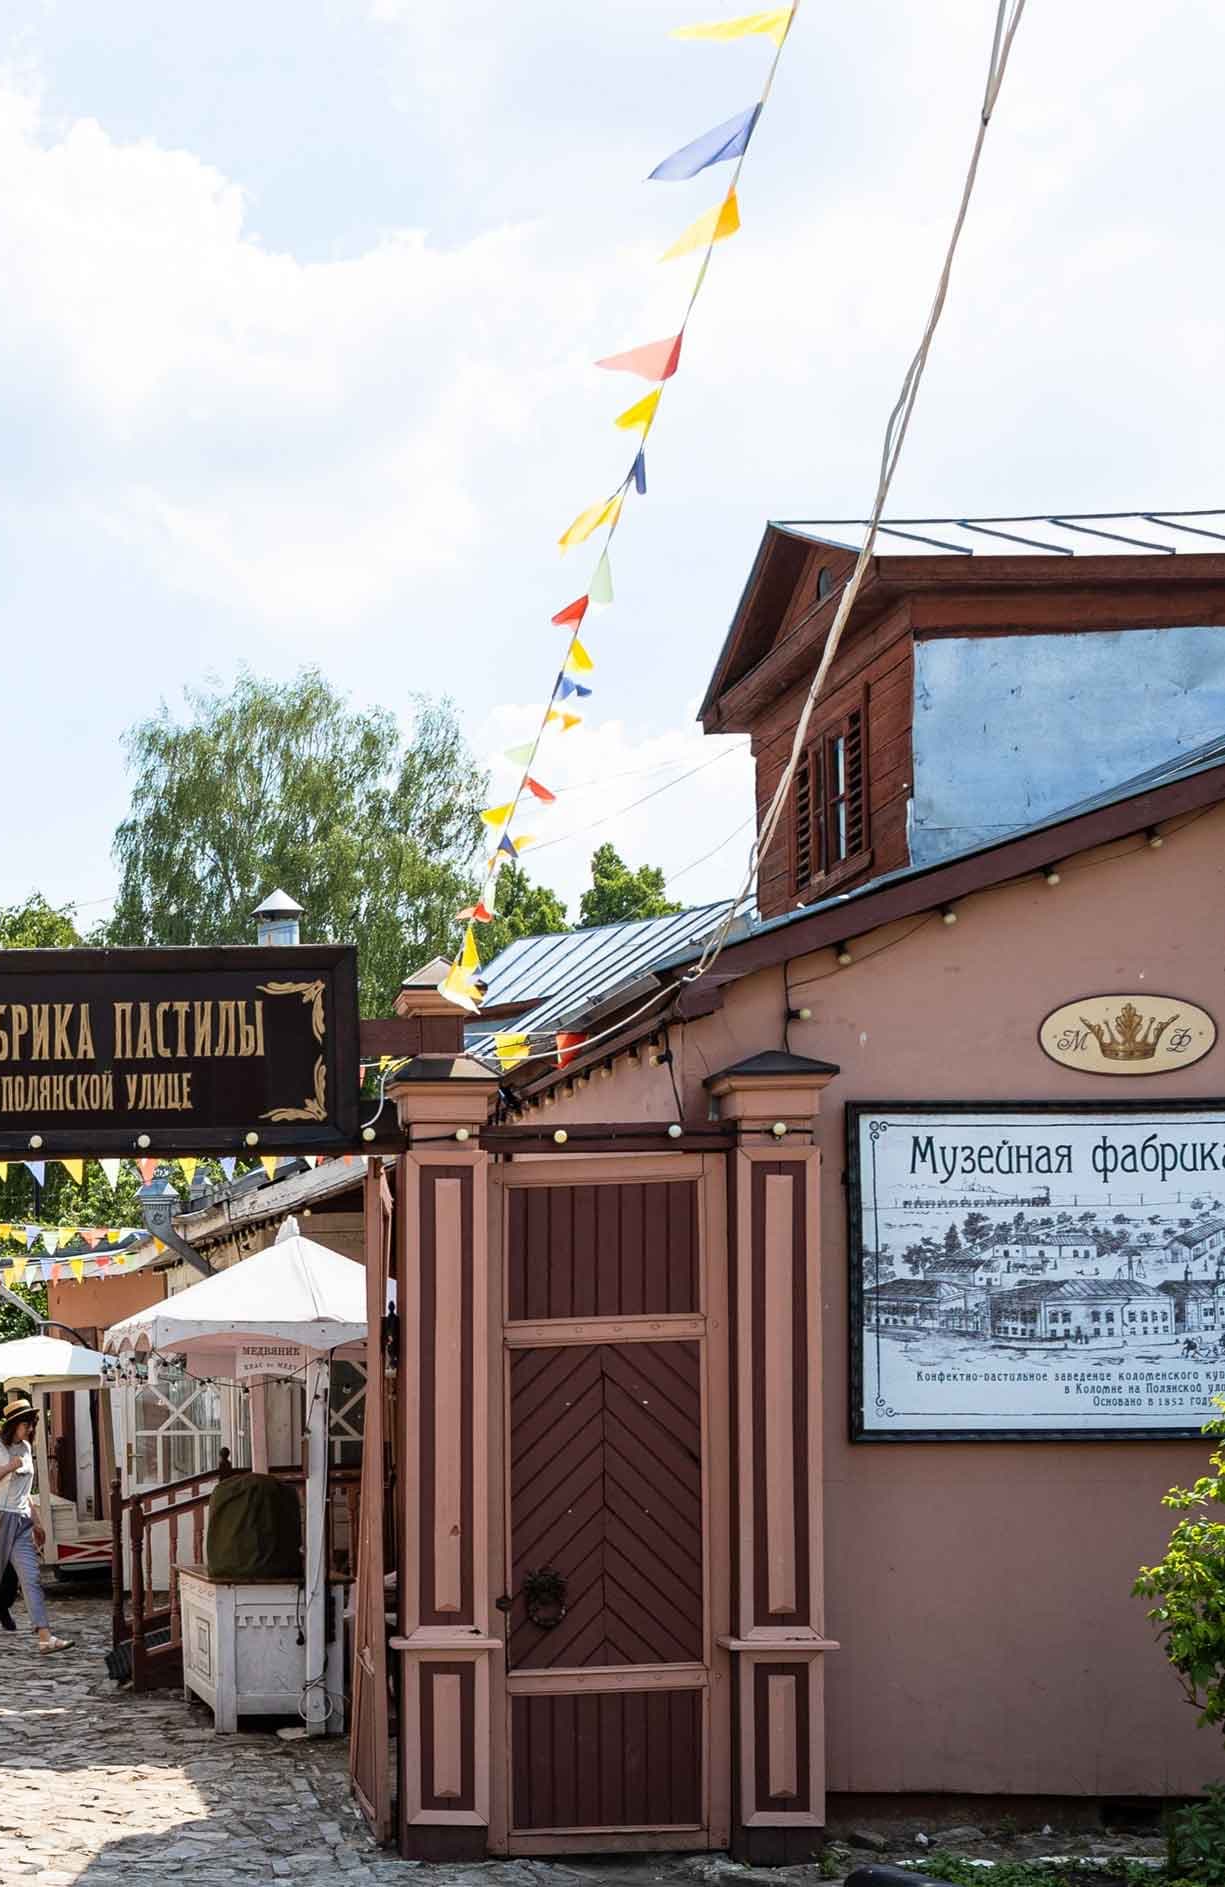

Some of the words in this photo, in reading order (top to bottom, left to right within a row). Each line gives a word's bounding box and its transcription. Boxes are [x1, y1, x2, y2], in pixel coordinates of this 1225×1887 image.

[113, 1001, 265, 1060] ПАСТИЛЫ
[0, 1070, 114, 1112] ПОЛЯНСКОЙ
[125, 1073, 193, 1112] УЛИЦЕ
[910, 1136, 1073, 1184] Музейная
[1092, 1133, 1225, 1183] фабрик
[1054, 1371, 1112, 1382] заведение
[1118, 1370, 1199, 1381] коломенского
[1076, 1384, 1123, 1394] Коломне
[1146, 1382, 1202, 1393] Полянской
[1092, 1395, 1142, 1407] Основано
[1158, 1397, 1184, 1406] 1852
